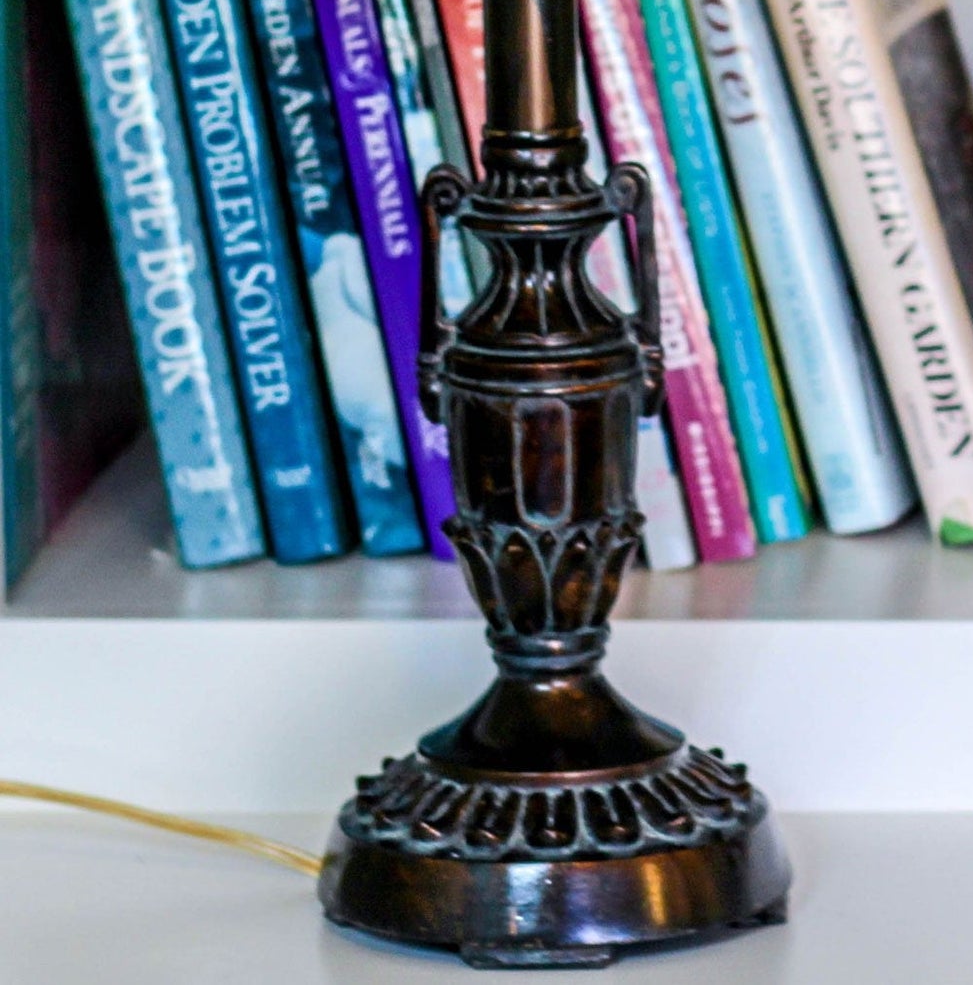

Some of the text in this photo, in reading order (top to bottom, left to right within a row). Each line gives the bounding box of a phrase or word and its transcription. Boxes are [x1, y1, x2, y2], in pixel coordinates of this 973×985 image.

[190, 70, 261, 257] PROBLEM
[228, 260, 290, 412] SOLVER
[279, 83, 330, 218] ANNUAL
[827, 33, 922, 268] SOUTHERN
[137, 243, 203, 395] BOOK
